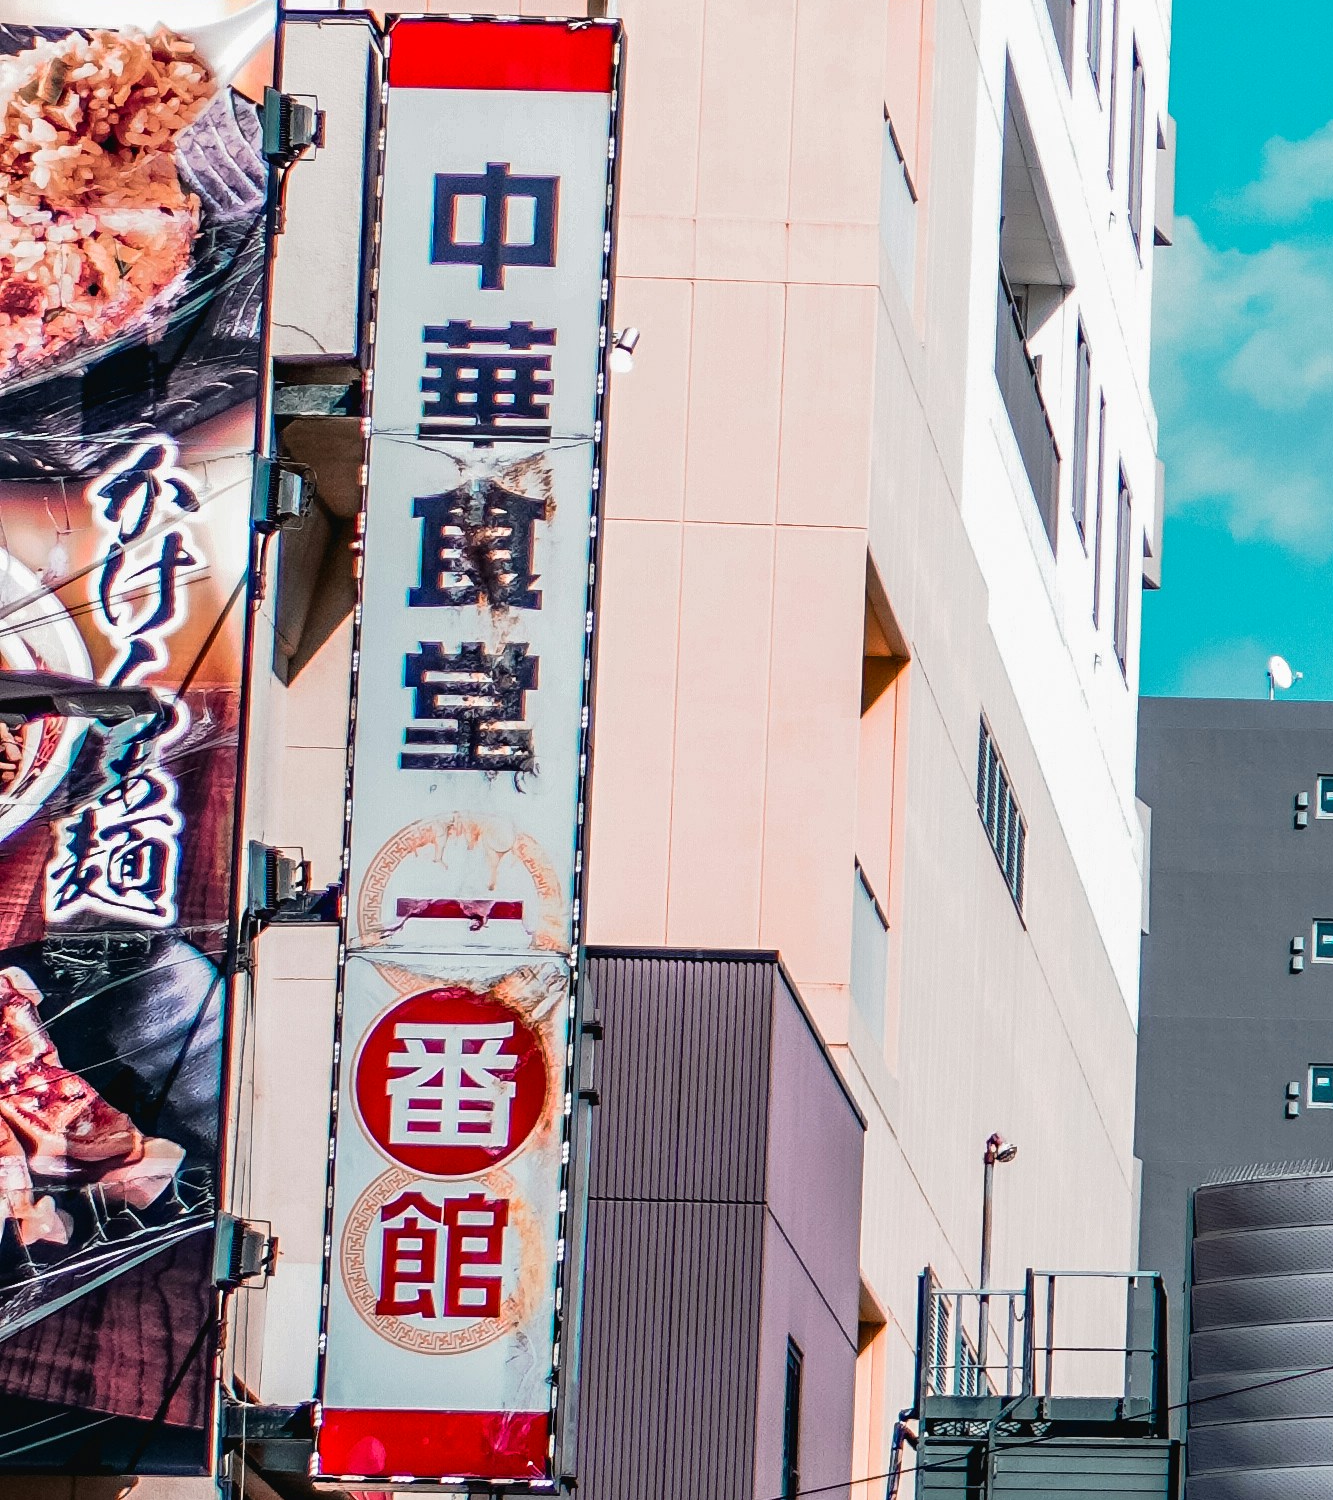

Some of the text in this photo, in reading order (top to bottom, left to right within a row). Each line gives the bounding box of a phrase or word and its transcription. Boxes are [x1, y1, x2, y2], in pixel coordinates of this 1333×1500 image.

[374, 161, 561, 1321] 中華食堂 一番館
